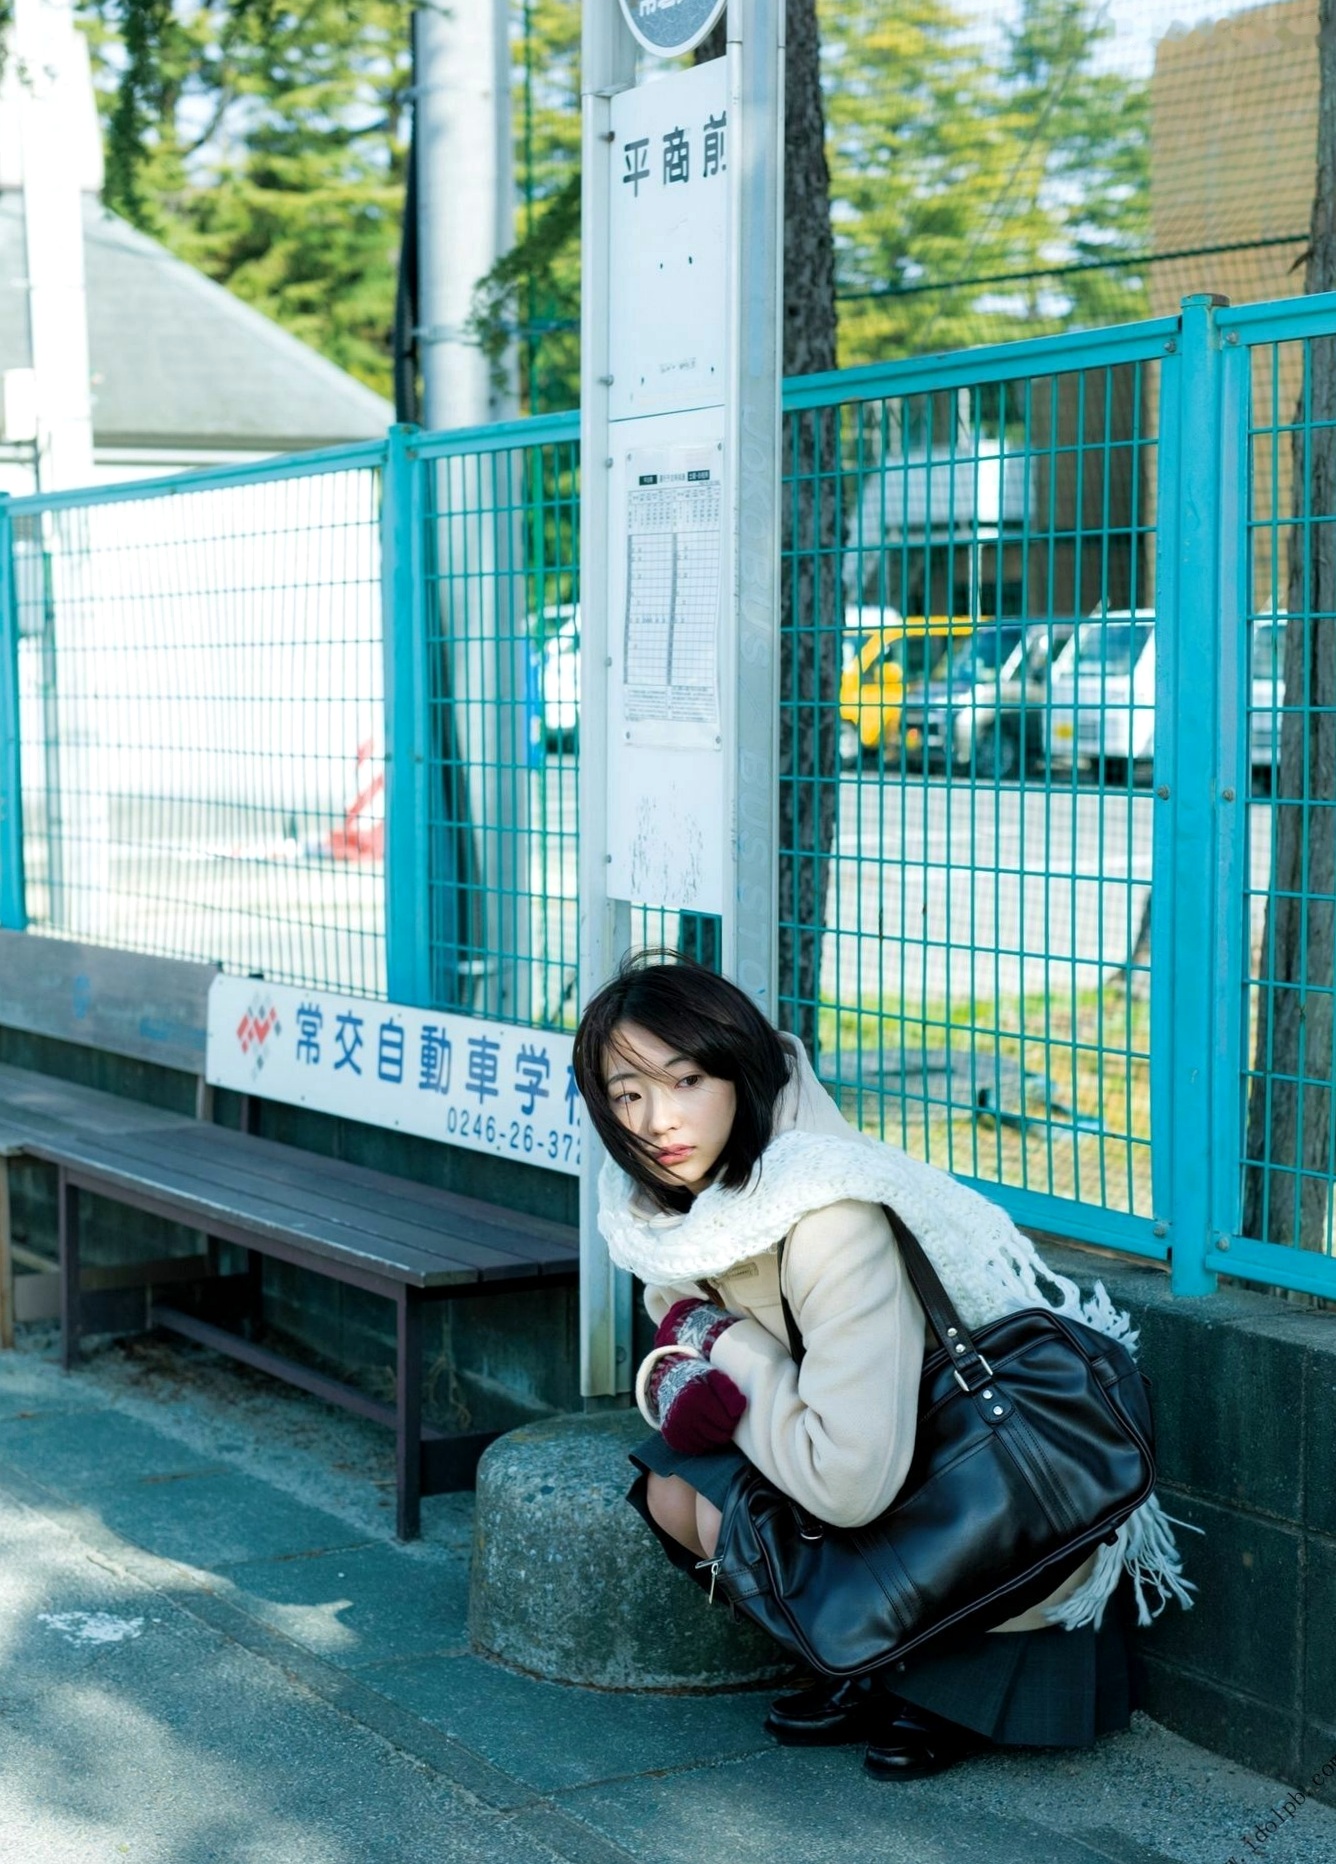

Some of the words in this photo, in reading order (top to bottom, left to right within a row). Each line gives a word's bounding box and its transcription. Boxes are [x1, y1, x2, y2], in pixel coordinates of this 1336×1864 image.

[622, 110, 727, 198] 平商前
[739, 879, 770, 1008] STO
